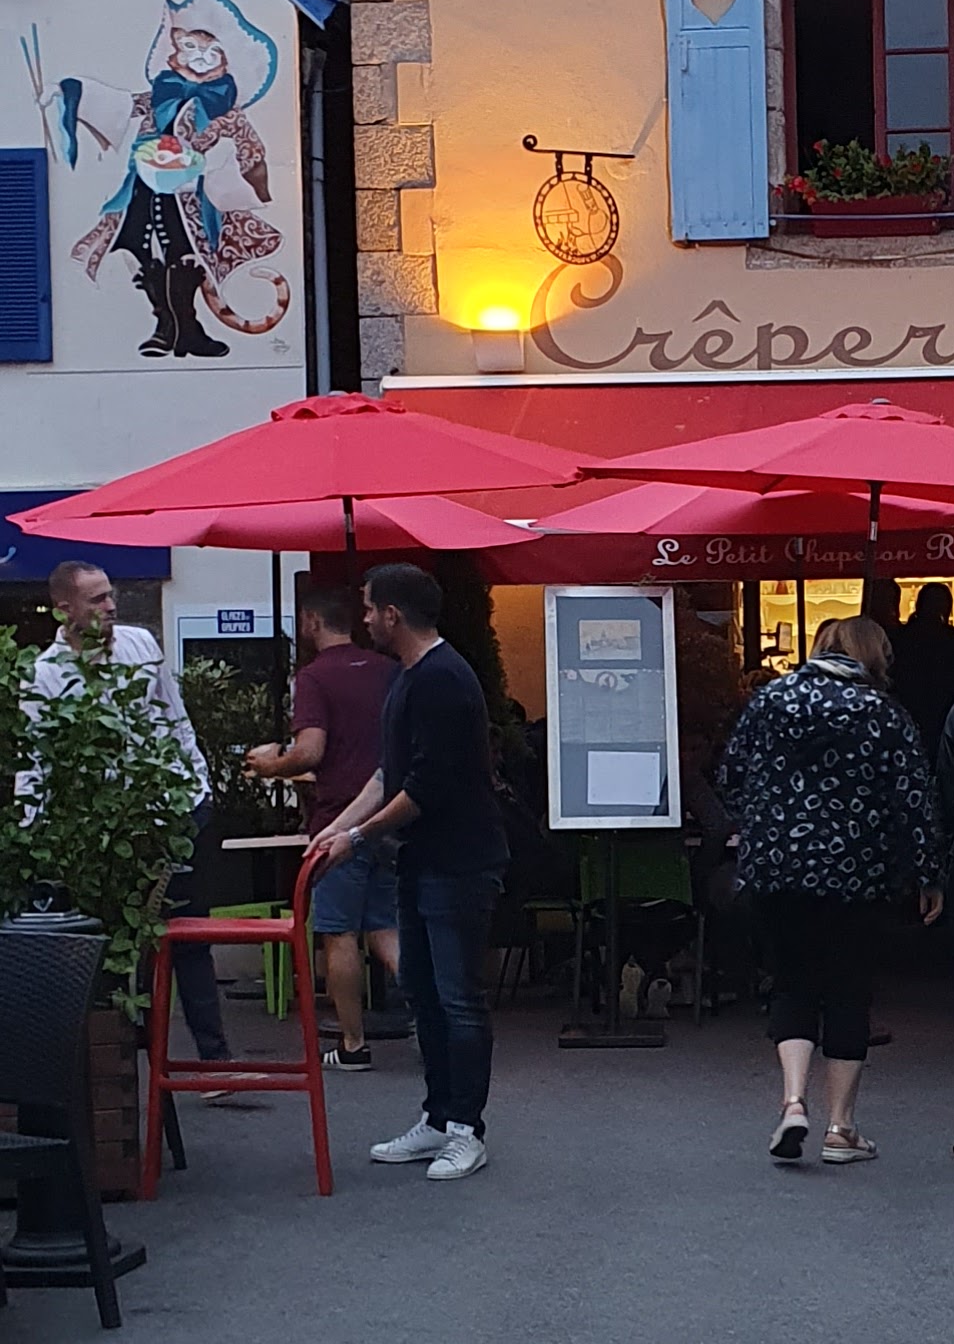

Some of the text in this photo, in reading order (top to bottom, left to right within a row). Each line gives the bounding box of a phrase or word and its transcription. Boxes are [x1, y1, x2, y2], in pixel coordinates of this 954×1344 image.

[652, 538, 698, 565] Le
[706, 537, 774, 564] Petit
[784, 536, 916, 571] Chapeon
